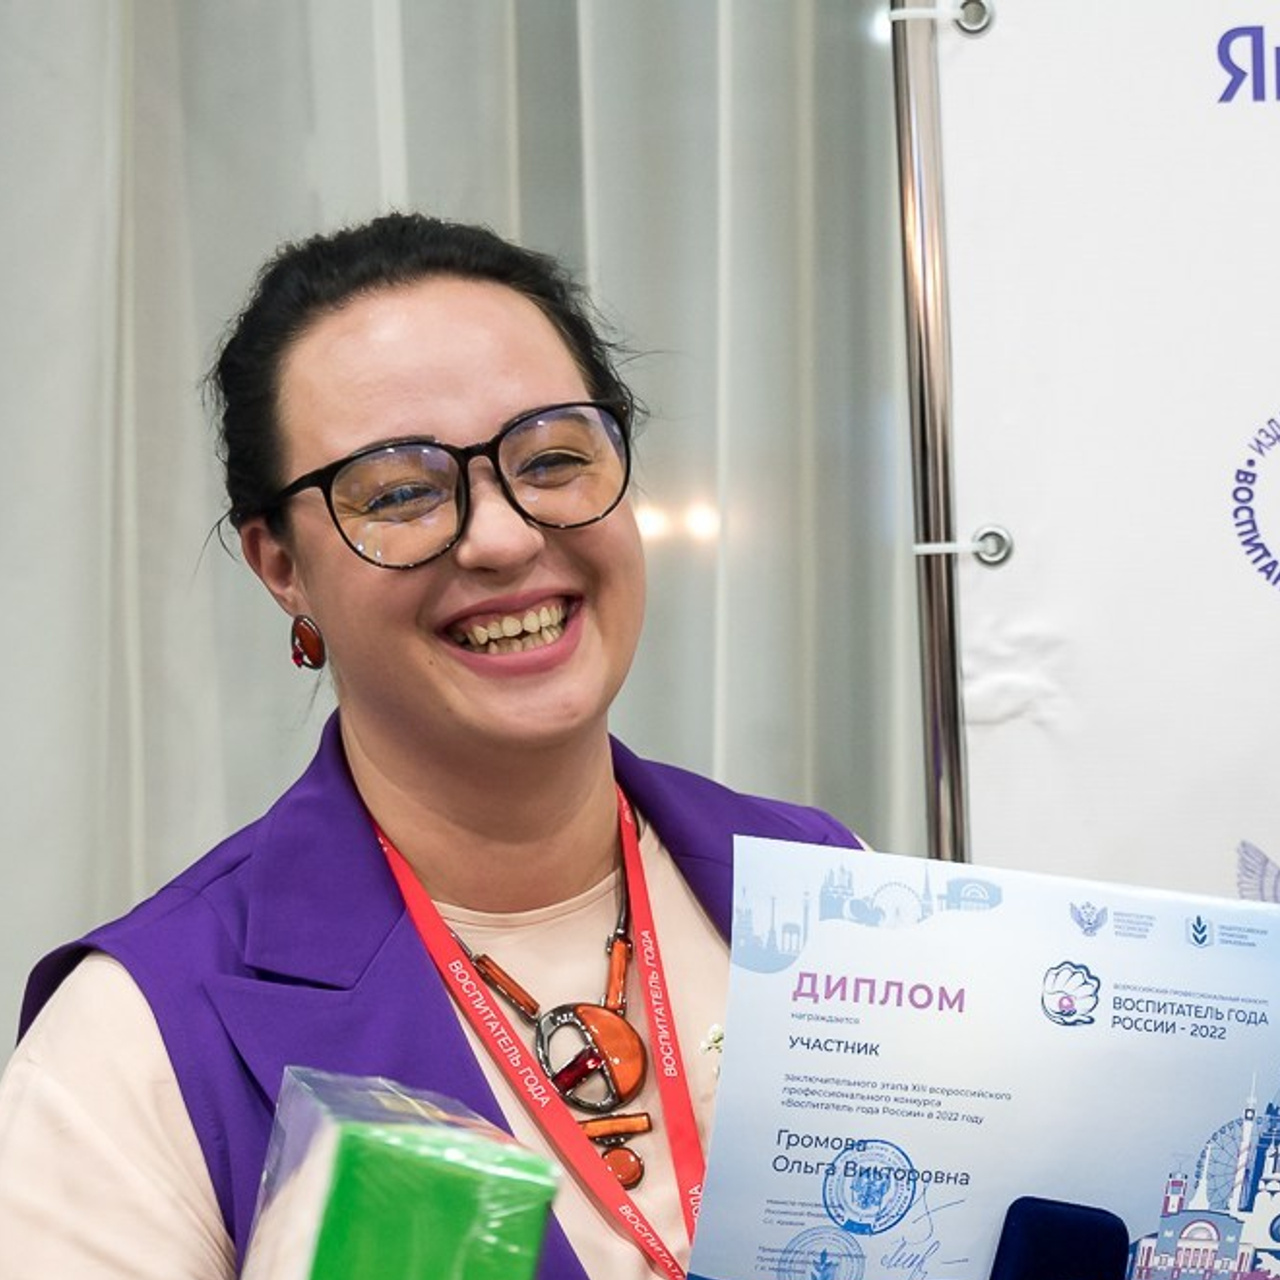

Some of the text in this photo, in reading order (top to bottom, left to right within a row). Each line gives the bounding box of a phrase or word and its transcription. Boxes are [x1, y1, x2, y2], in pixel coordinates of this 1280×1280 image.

[641, 930, 679, 1077] ВОСПИТАТЕЛЬ ГОДА
[792, 971, 966, 1013] ДИПЛОМ
[1112, 996, 1269, 1026] ВОСПИТАТЕЛЬ ГОДА
[448, 959, 551, 1108] ВОСПИТАТЕЛЬ ГОДА
[1111, 1015, 1176, 1034] РОССИИ
[1189, 1023, 1226, 1040] 2022
[788, 1035, 880, 1057] УЧАСТНИК
[935, 1111, 959, 1122] 2022
[961, 1114, 985, 1126] году
[776, 1129, 868, 1152] Громова
[772, 1155, 971, 1186] Ольга Викторовна
